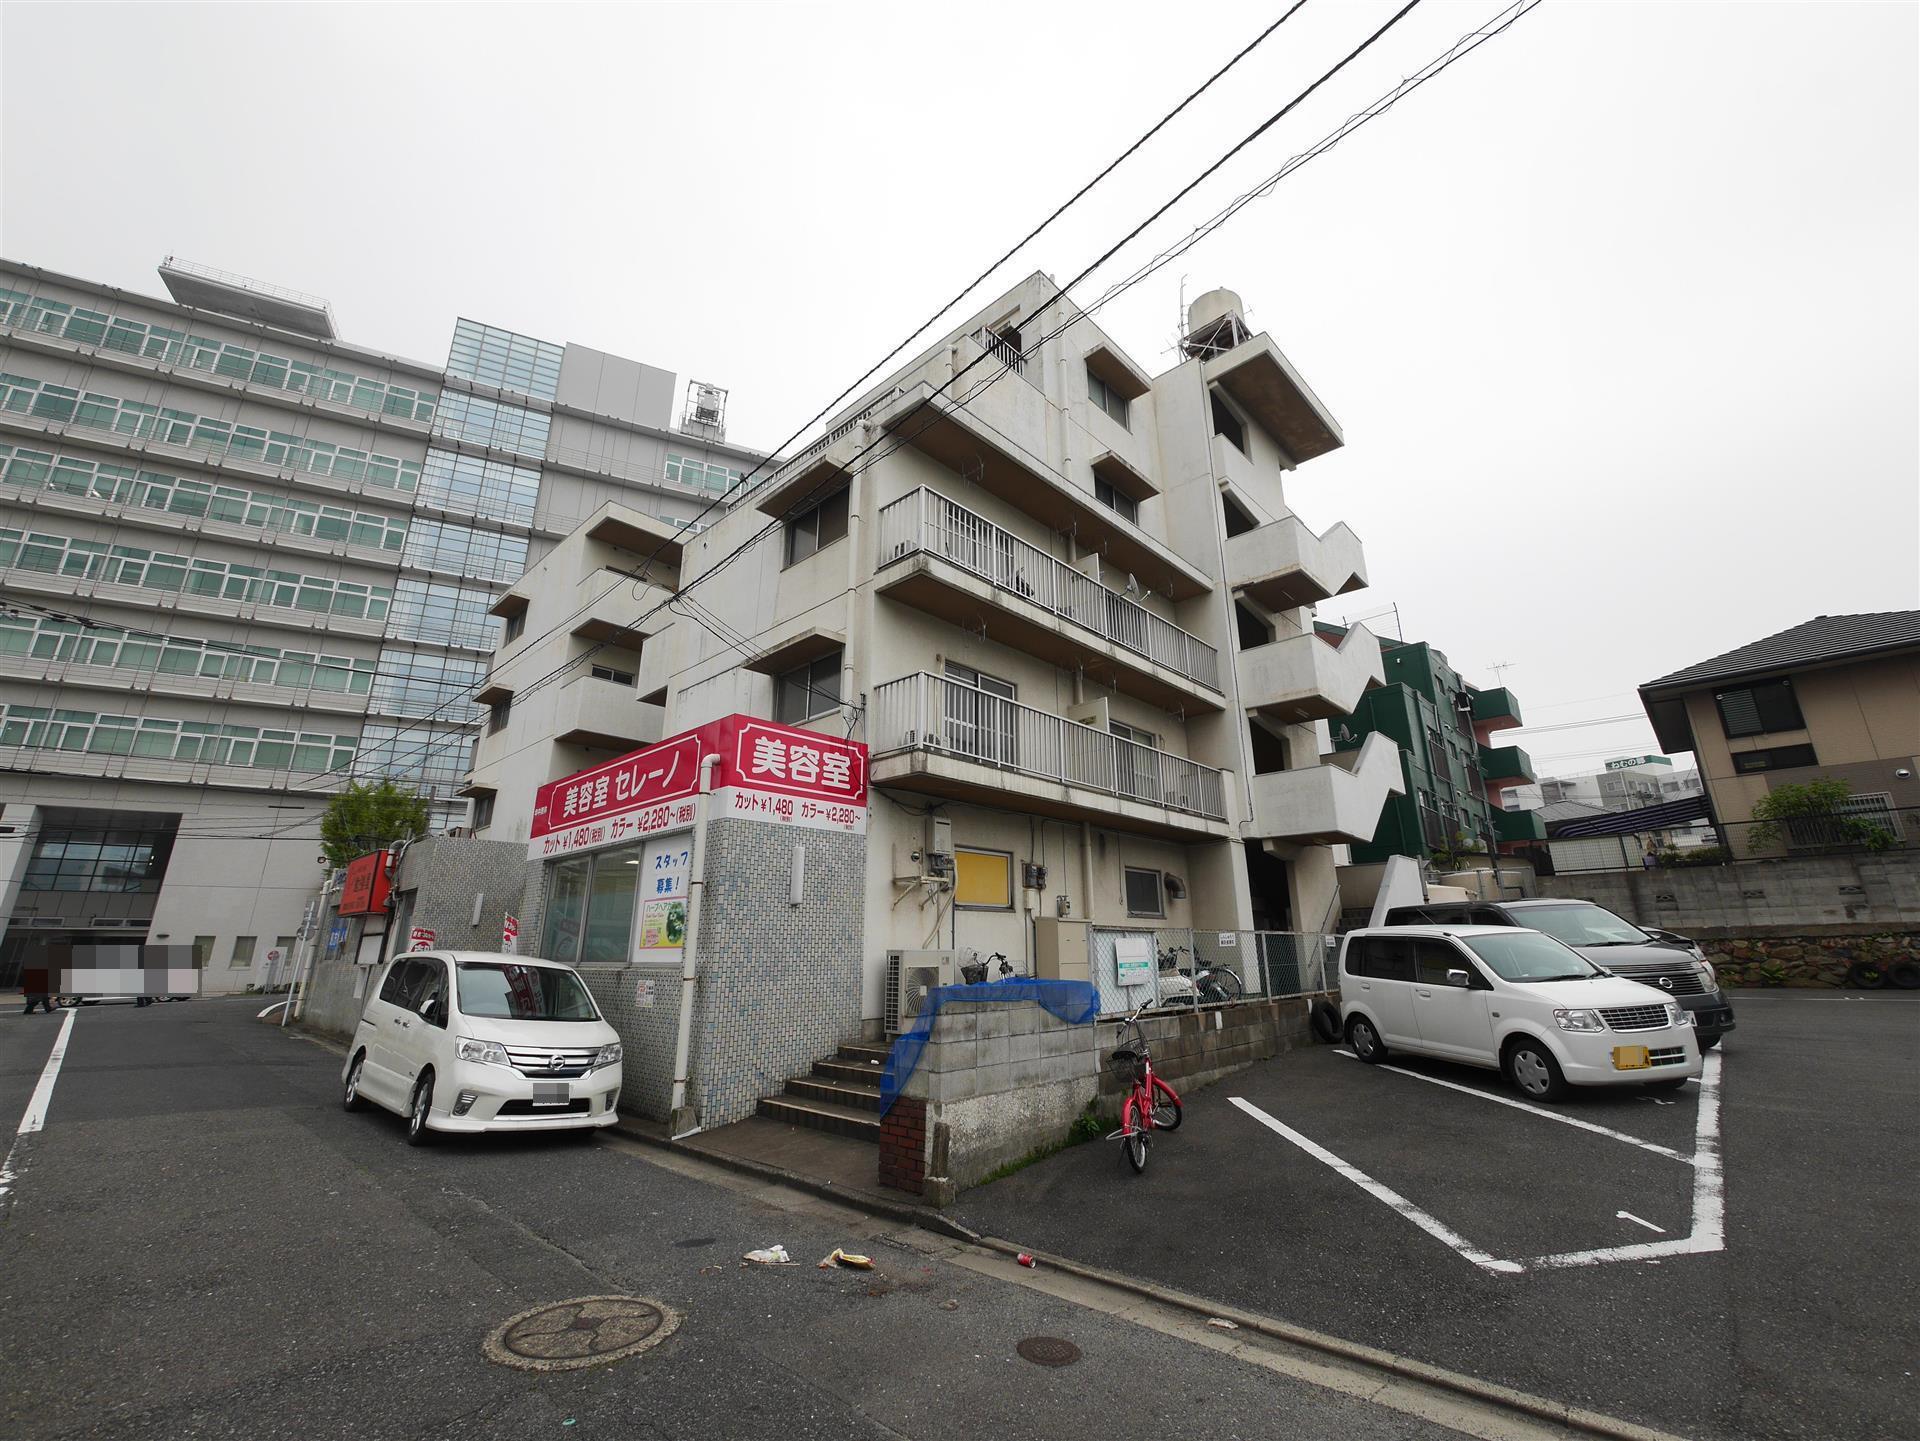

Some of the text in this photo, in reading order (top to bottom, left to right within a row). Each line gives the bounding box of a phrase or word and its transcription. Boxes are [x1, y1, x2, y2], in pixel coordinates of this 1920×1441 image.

[752, 736, 850, 790] 美容室
[563, 751, 680, 818] 美容室 セレーノ
[735, 792, 759, 811] カット
[761, 797, 793, 816] ¥1,480
[801, 801, 824, 819] カラー
[543, 834, 561, 855] カット
[611, 817, 633, 839] カラー
[655, 851, 688, 869] スタッフ
